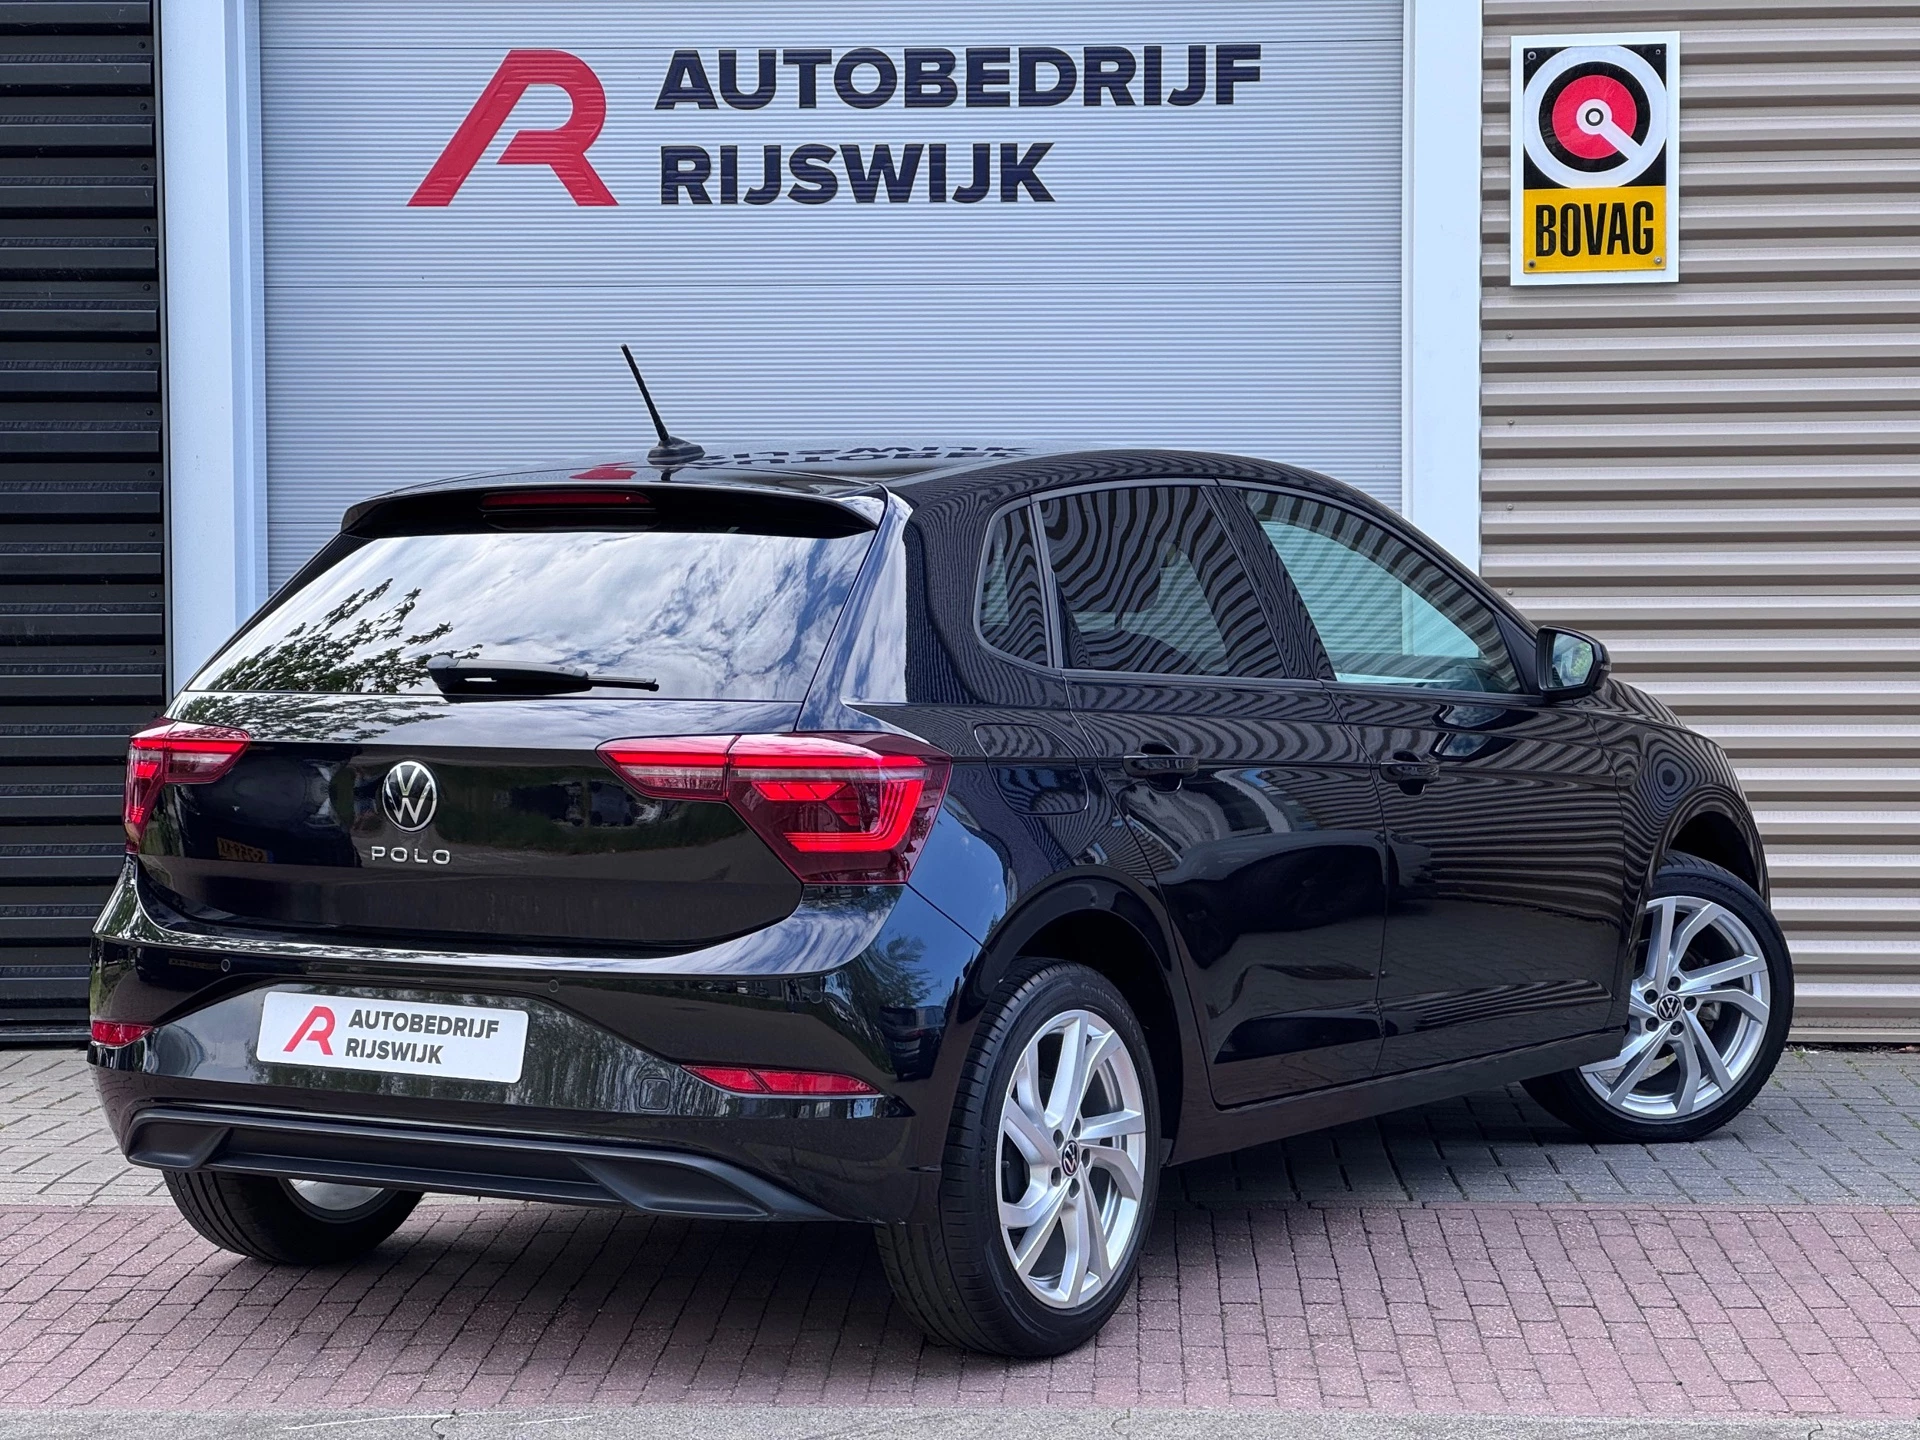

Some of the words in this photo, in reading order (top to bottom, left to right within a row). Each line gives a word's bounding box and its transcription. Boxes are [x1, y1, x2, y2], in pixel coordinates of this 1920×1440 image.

[654, 44, 1262, 110] AUTOBEDRIJF
[660, 142, 1056, 205] RIJSWIJK
[1535, 200, 1654, 257] BOVAG
[371, 846, 452, 865] POLO
[348, 1009, 500, 1040] AUTOBEDRIJF
[345, 1037, 443, 1065] RIJSWIJK
